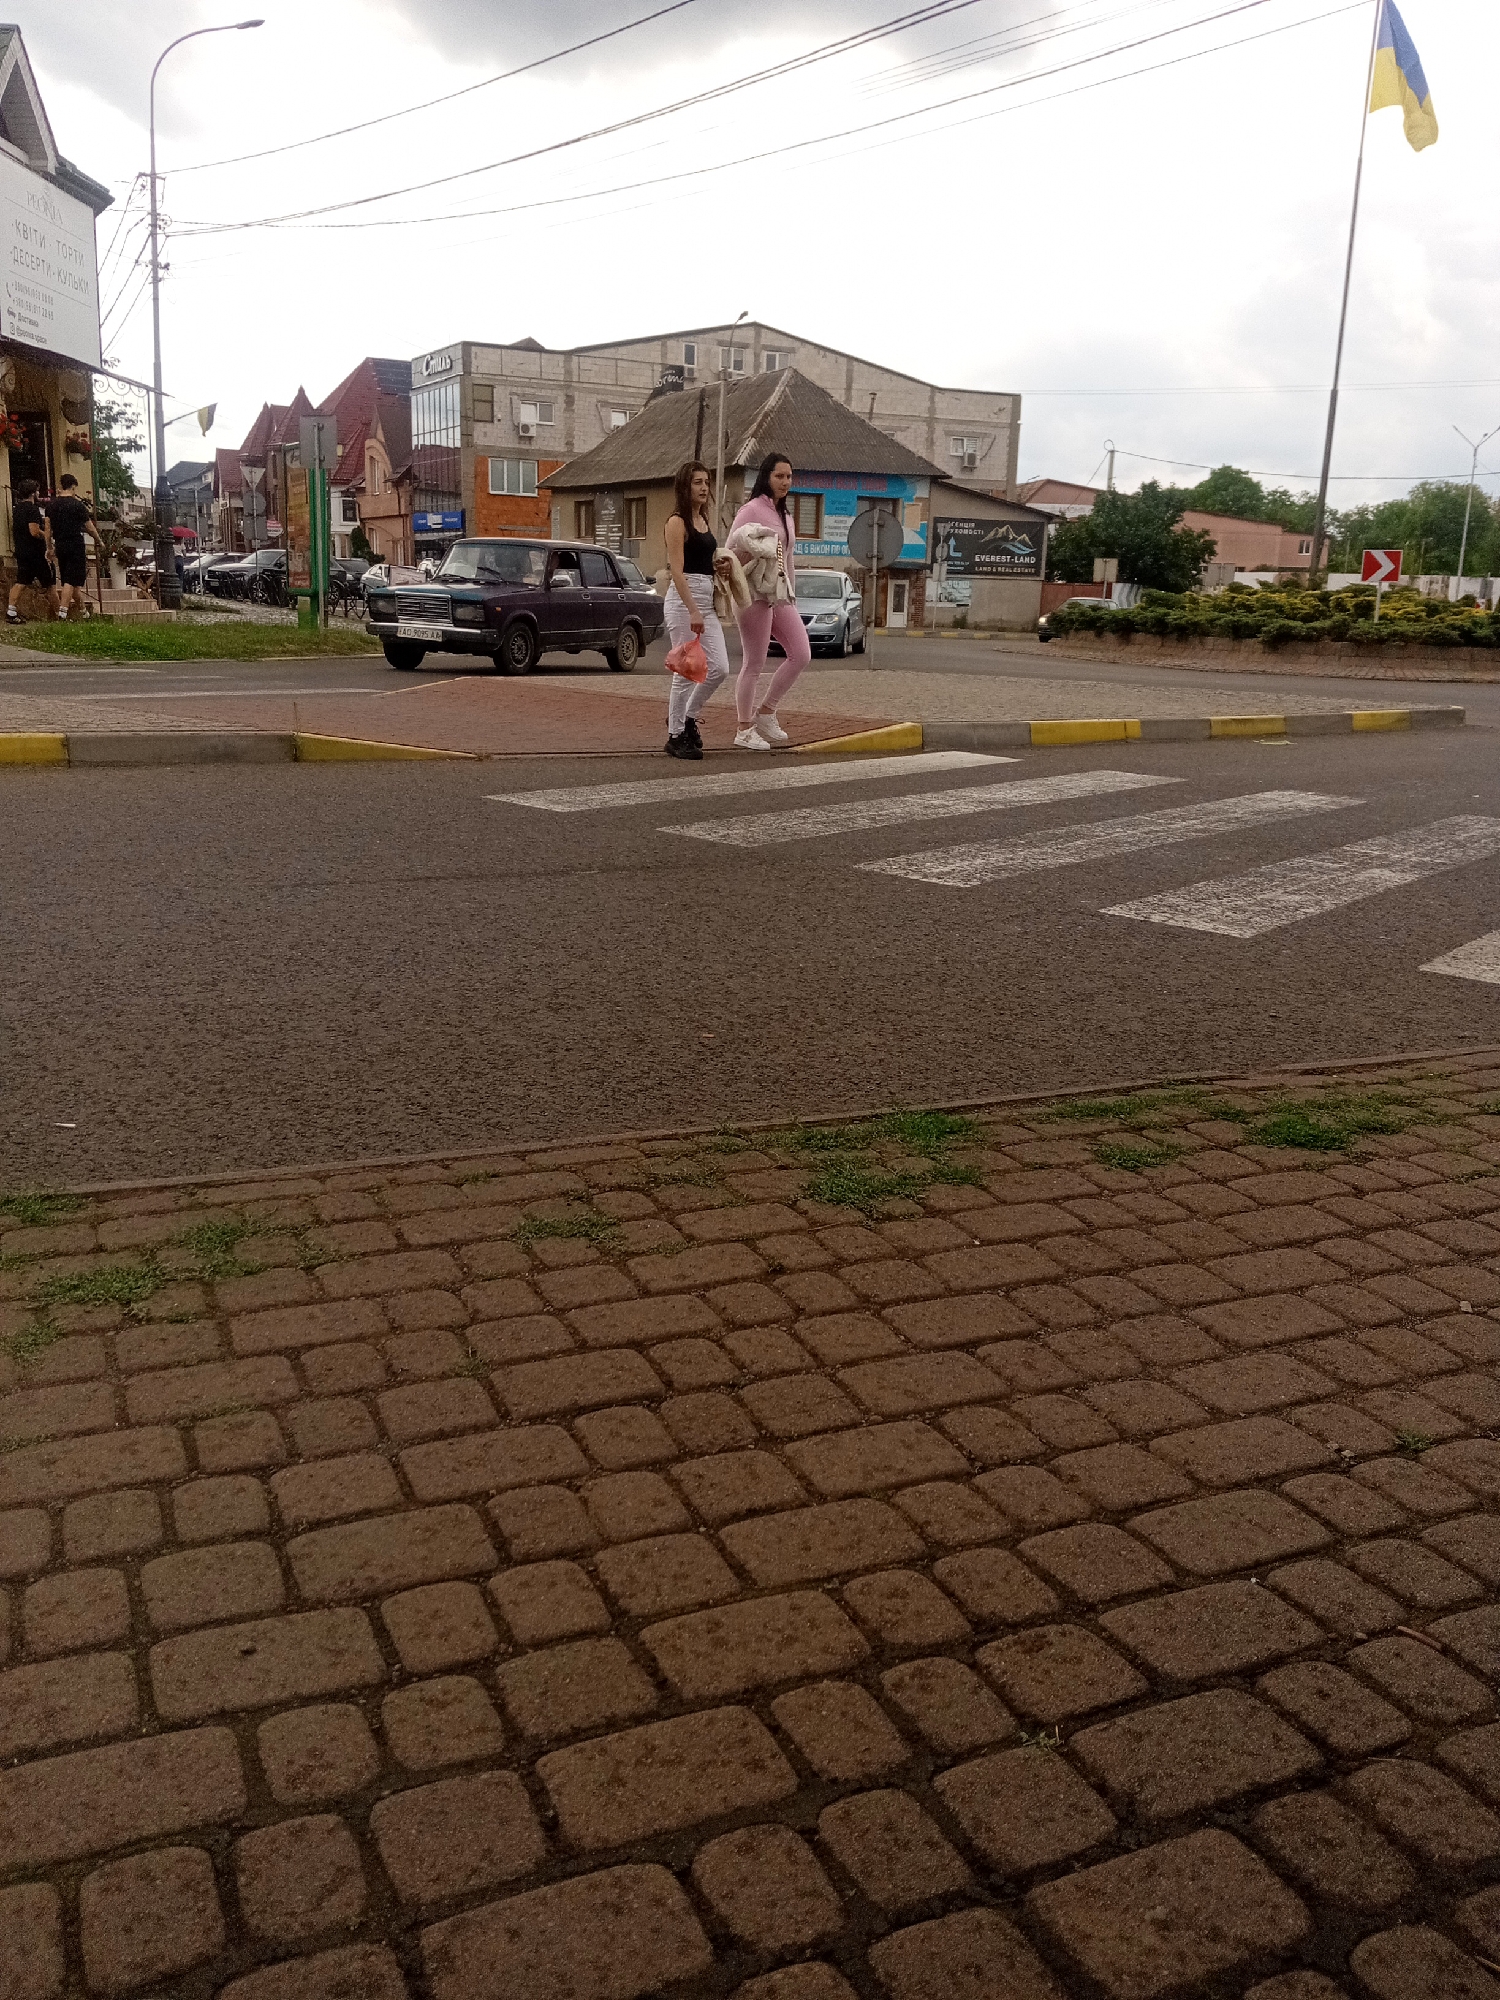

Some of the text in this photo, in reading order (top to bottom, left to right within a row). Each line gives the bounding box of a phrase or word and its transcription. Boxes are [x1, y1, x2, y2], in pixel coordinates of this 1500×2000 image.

[15, 219, 85, 267] КВІТИ ТОРТИ
[13, 246, 51, 278] ДЕСЕРТИ
[57, 267, 89, 295] КУЛЬКИ
[949, 521, 975, 529] ГЕНЦІЯ
[975, 554, 1037, 564] EVEREST-LAND
